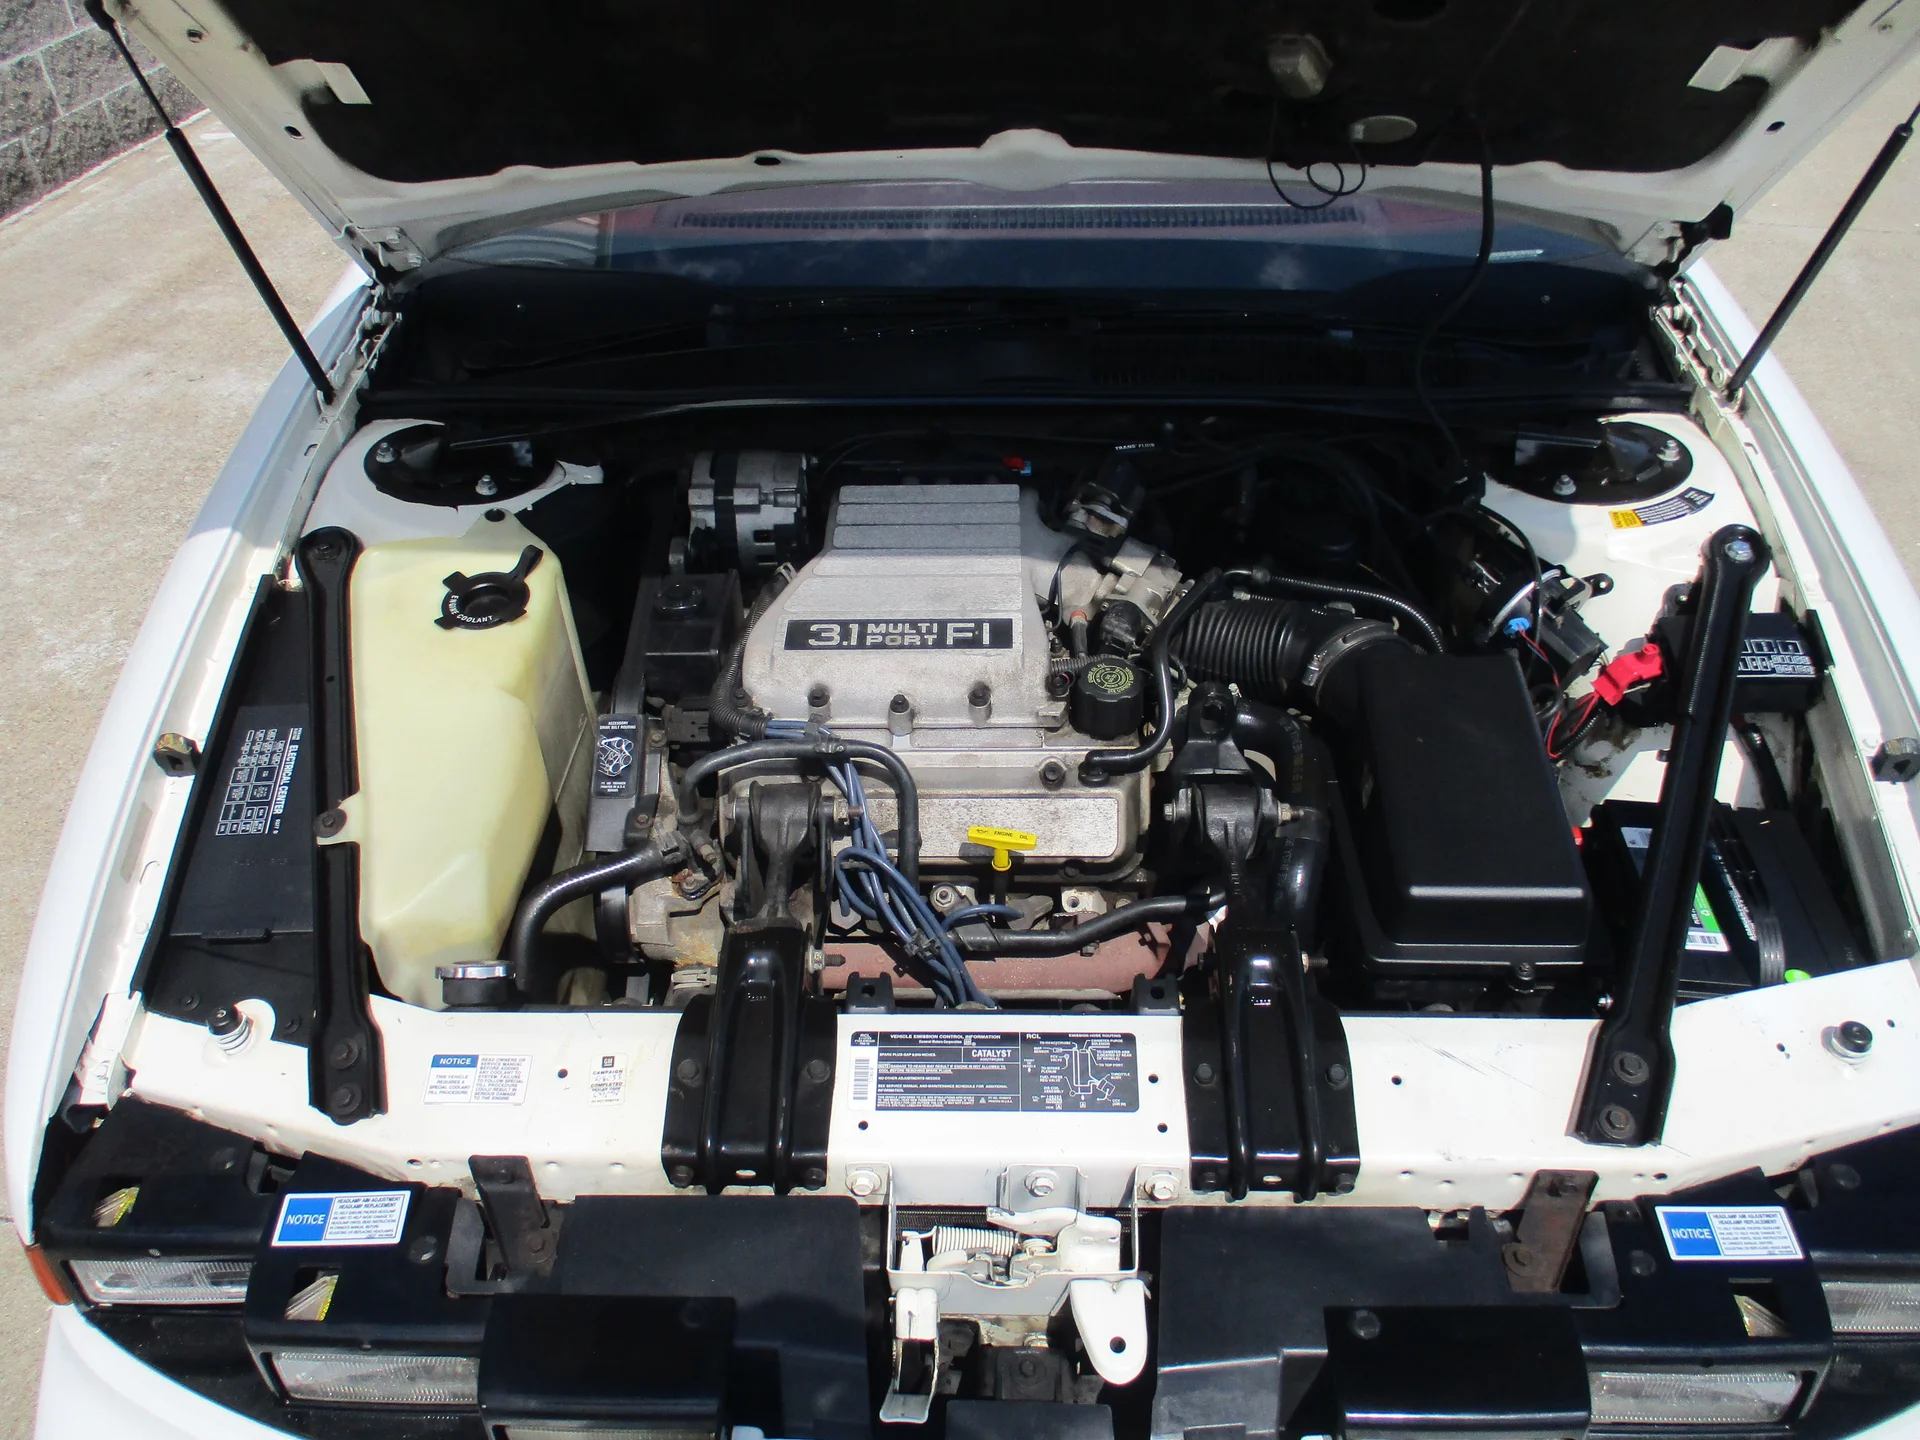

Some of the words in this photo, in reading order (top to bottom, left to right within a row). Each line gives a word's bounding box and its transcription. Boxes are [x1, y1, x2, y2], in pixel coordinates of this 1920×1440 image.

[448, 594, 460, 615] ENGINE
[456, 614, 492, 624] COOLANT
[808, 623, 858, 646] 3.1
[866, 622, 938, 634] MULTI
[946, 622, 990, 646] FI
[866, 634, 938, 646] PORT
[280, 745, 298, 786] ELECTRICAL
[272, 786, 288, 814] CENTER
[286, 1214, 326, 1225] NOTICE
[1671, 1228, 1712, 1239] NOTICE
